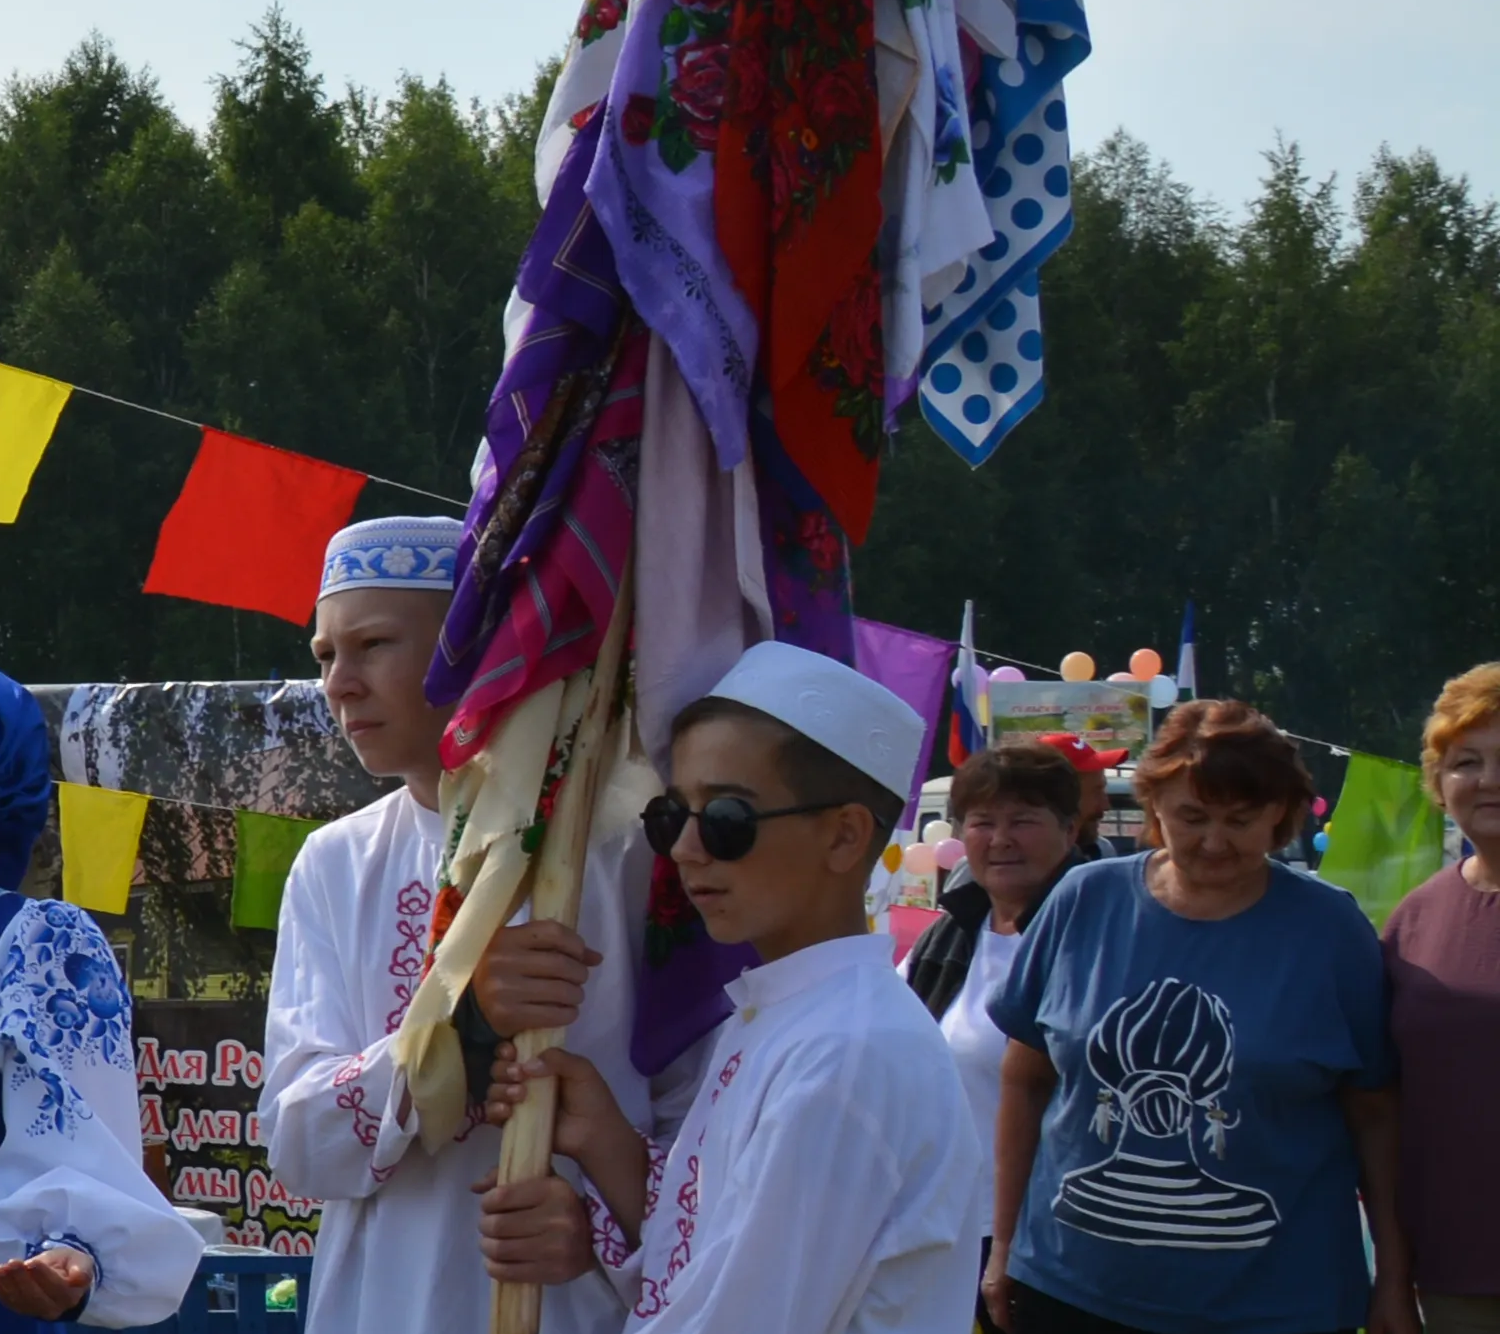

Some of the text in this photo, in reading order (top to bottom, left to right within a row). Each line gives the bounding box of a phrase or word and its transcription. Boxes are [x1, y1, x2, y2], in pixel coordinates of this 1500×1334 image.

[136, 1041, 264, 1088] Для Ро
[174, 1111, 241, 1149] для
[176, 1170, 239, 1201] мы
